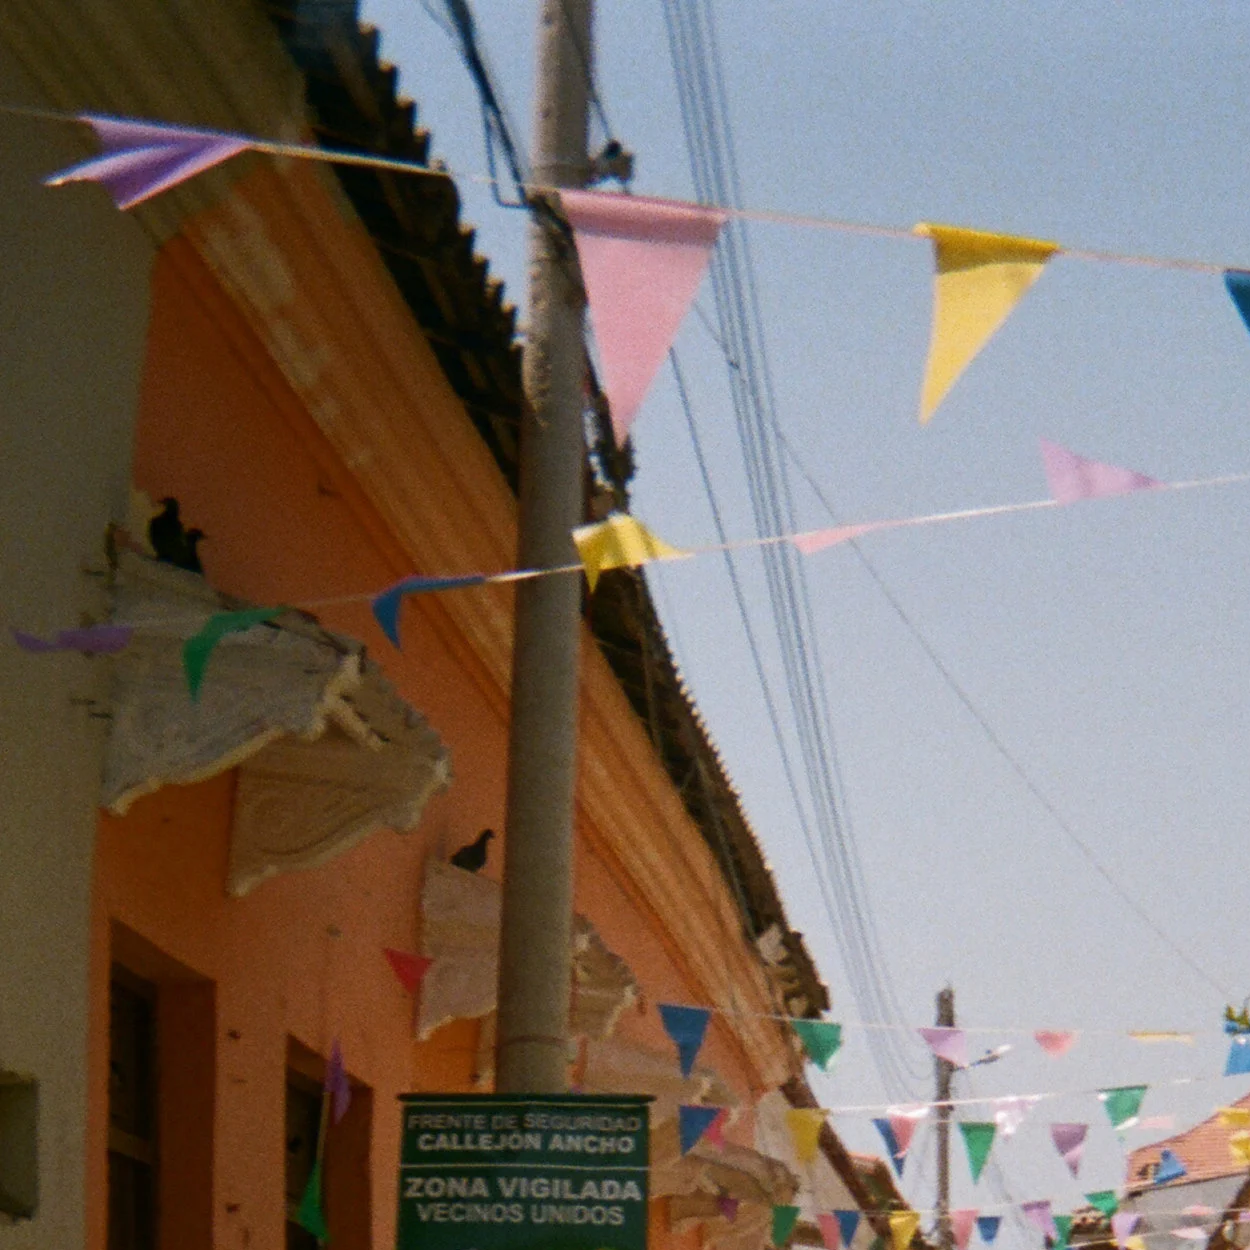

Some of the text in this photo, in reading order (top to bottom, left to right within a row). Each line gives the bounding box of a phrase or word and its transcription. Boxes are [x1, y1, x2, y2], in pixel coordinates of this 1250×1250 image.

[408, 1113, 642, 1132] FRENTE DE SEGURIDAD
[548, 1135, 635, 1153] ANCHO
[404, 1177, 642, 1201] ZONA VIGILADA
[416, 1203, 624, 1225] VECINOS UNIDOS
